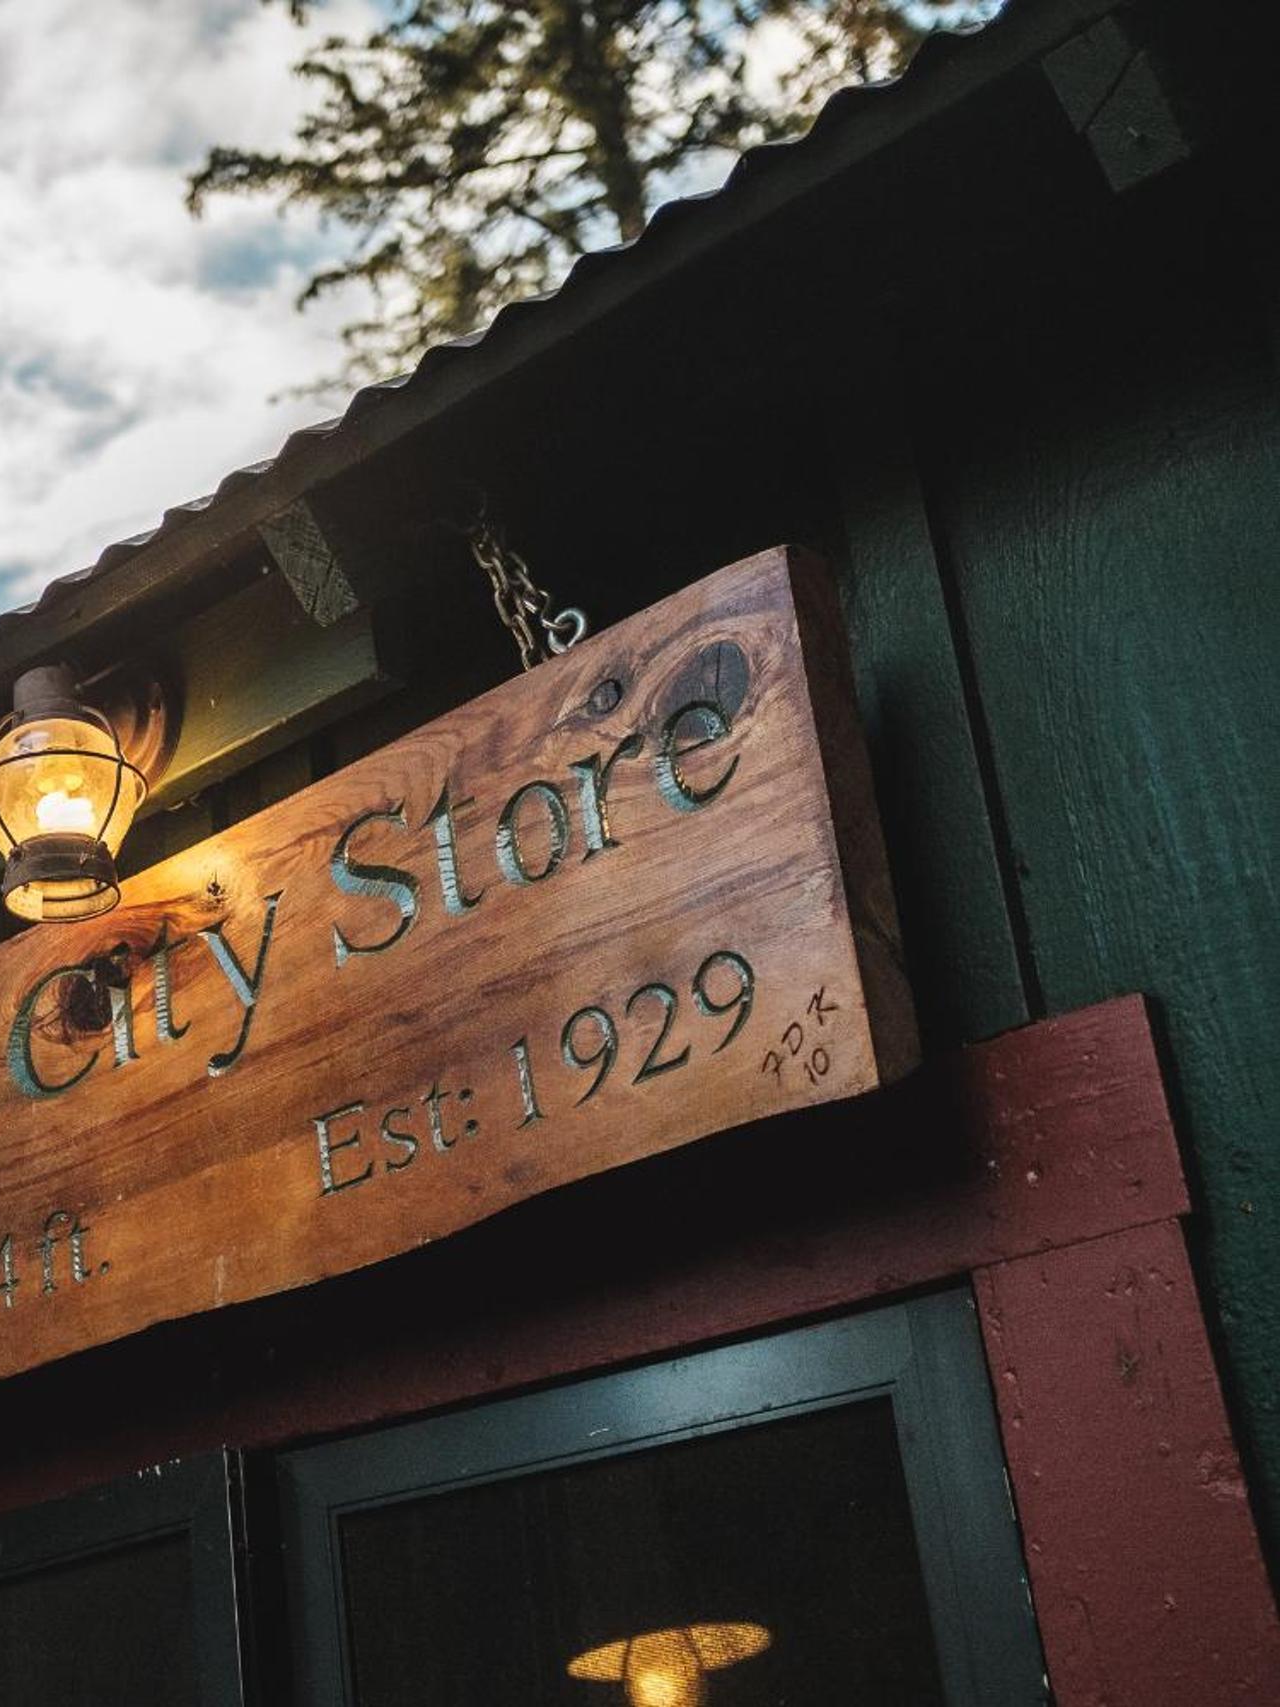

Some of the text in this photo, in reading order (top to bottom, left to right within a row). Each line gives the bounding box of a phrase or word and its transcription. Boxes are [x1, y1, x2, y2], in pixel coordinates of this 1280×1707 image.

[7, 888, 285, 1097] City
[330, 699, 741, 969] Store
[309, 949, 756, 1198] Est: 1929
[32, 1210, 112, 1297] ft.
